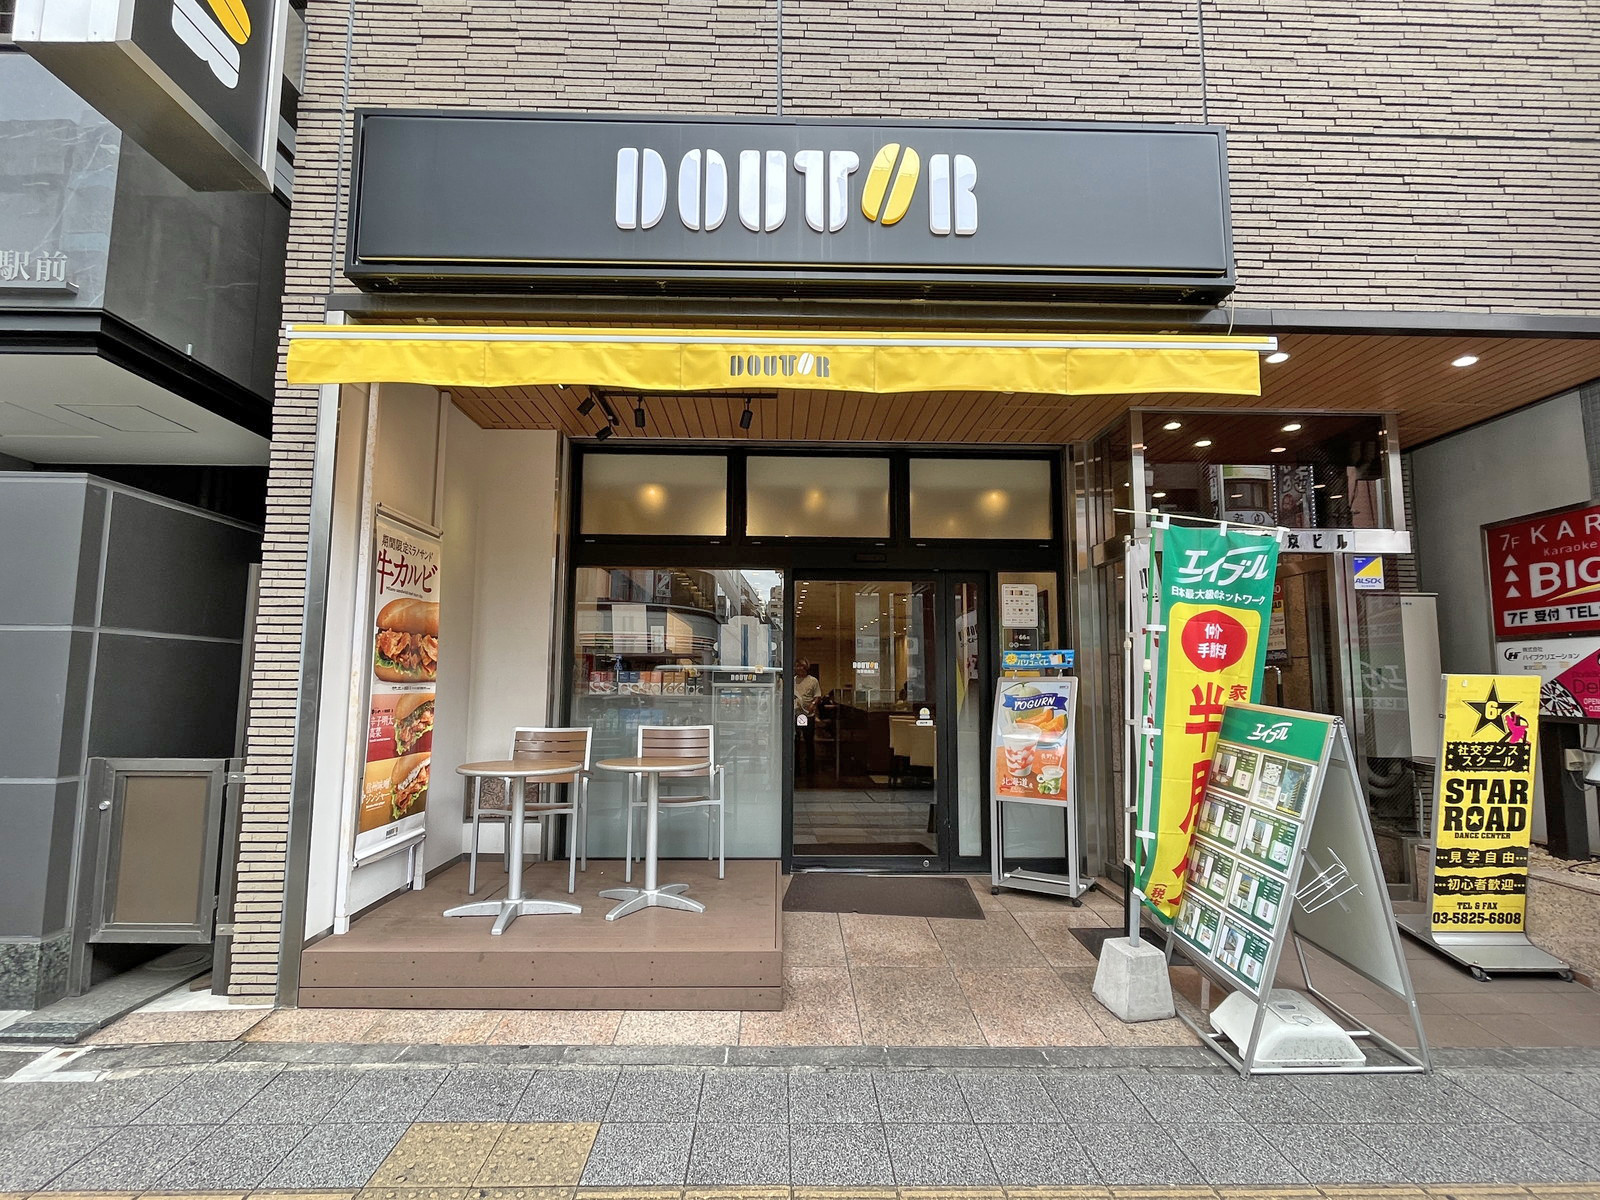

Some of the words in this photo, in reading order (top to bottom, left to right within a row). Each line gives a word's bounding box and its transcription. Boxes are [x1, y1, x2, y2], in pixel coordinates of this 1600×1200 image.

[615, 143, 978, 236] DOUTOR
[730, 352, 829, 377] DOUTOR
[1500, 534, 1520, 552] 7F
[1543, 541, 1598, 556] Karaoke
[377, 549, 438, 595] 牛カルビ
[1175, 545, 1272, 586] エイブル
[1528, 556, 1600, 598] BIG
[1507, 612, 1528, 624] 7F
[1535, 609, 1560, 622] 受付
[1566, 605, 1599, 619] TEL
[1014, 696, 1056, 711] YOGURN
[1247, 722, 1293, 743] エイブル
[1458, 745, 1518, 756] 社交ダンス
[1462, 756, 1514, 767] スクール
[1445, 778, 1529, 804] STAR
[1443, 806, 1527, 831] ROAD
[1457, 902, 1472, 910] TEL
[1475, 902, 1480, 910] &
[1482, 902, 1498, 910] FAX
[1433, 912, 1521, 924] 03-5825-6808
